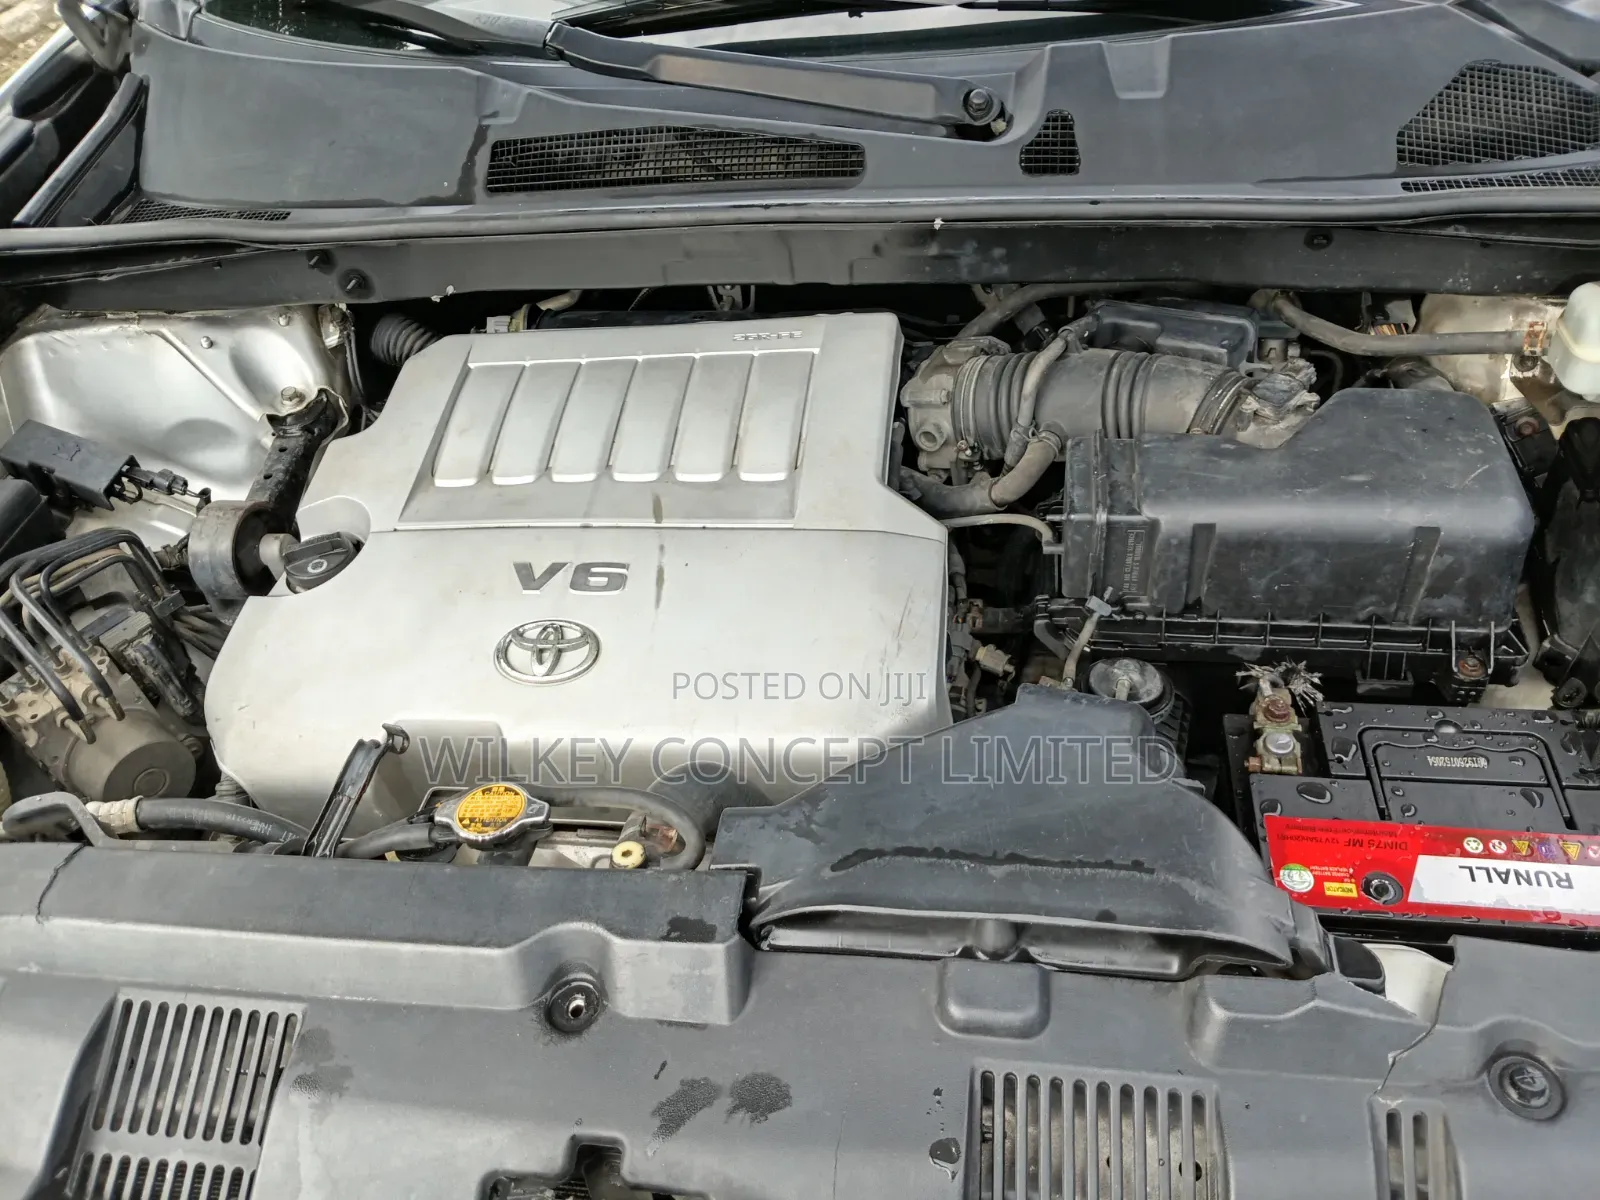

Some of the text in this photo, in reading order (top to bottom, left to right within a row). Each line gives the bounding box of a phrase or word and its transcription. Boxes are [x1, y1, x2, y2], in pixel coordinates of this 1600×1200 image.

[512, 561, 630, 595] V6
[1344, 837, 1364, 848] MF
[1367, 838, 1409, 851] DIN75
[1458, 865, 1574, 889] RUNALL
